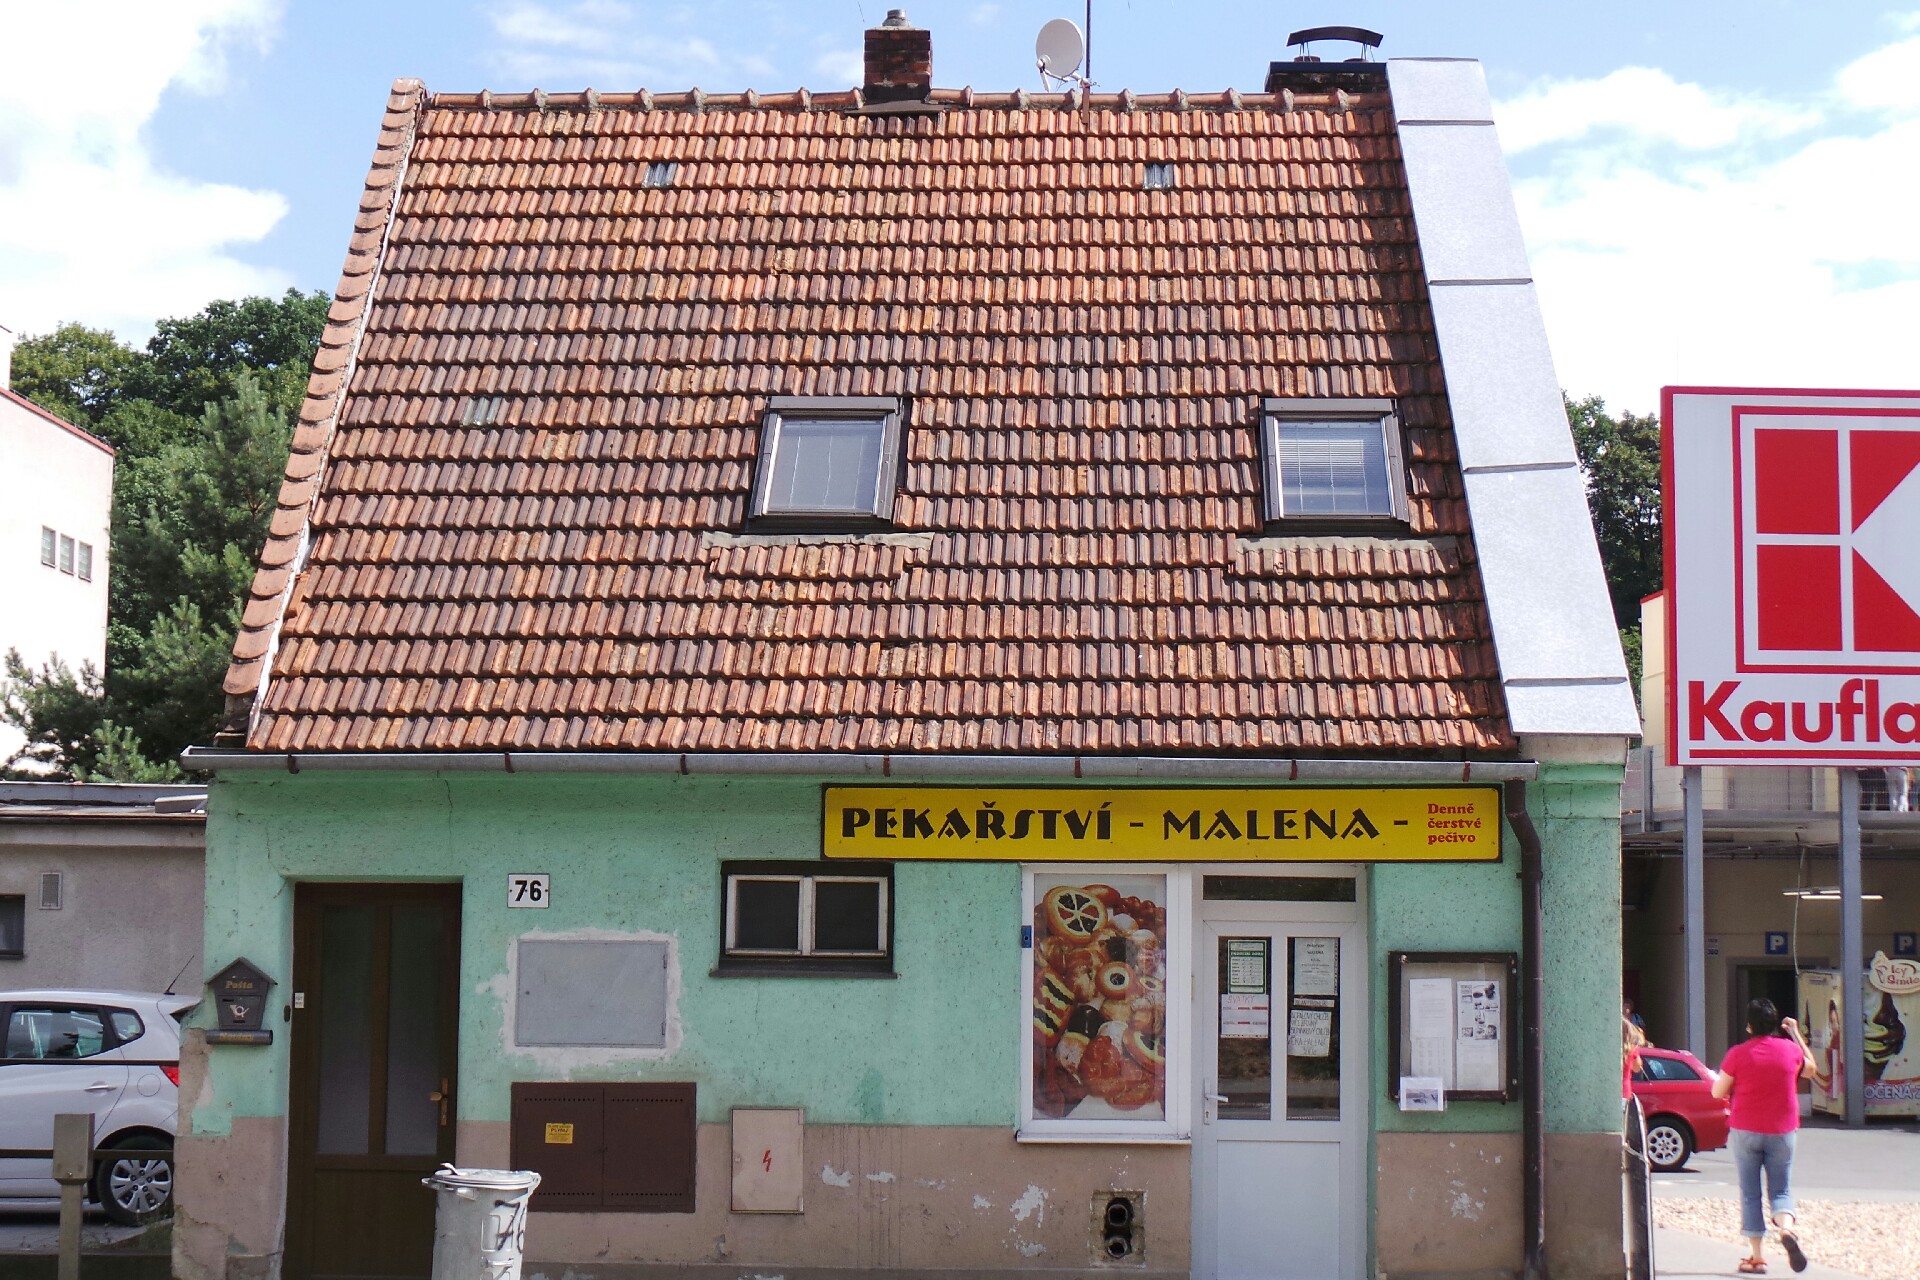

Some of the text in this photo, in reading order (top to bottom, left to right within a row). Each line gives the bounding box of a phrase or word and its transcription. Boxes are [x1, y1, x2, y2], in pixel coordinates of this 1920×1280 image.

[1427, 803, 1475, 815] Denně
[841, 800, 1112, 841] PEKAŘSTVÍ
[1162, 807, 1380, 841] MALENA
[1427, 817, 1482, 829] čerstvé
[1427, 832, 1476, 845] pečivo
[514, 879, 542, 902] 76
[1769, 934, 1785, 951] P
[1863, 1081, 1914, 1100] OČENÁ
